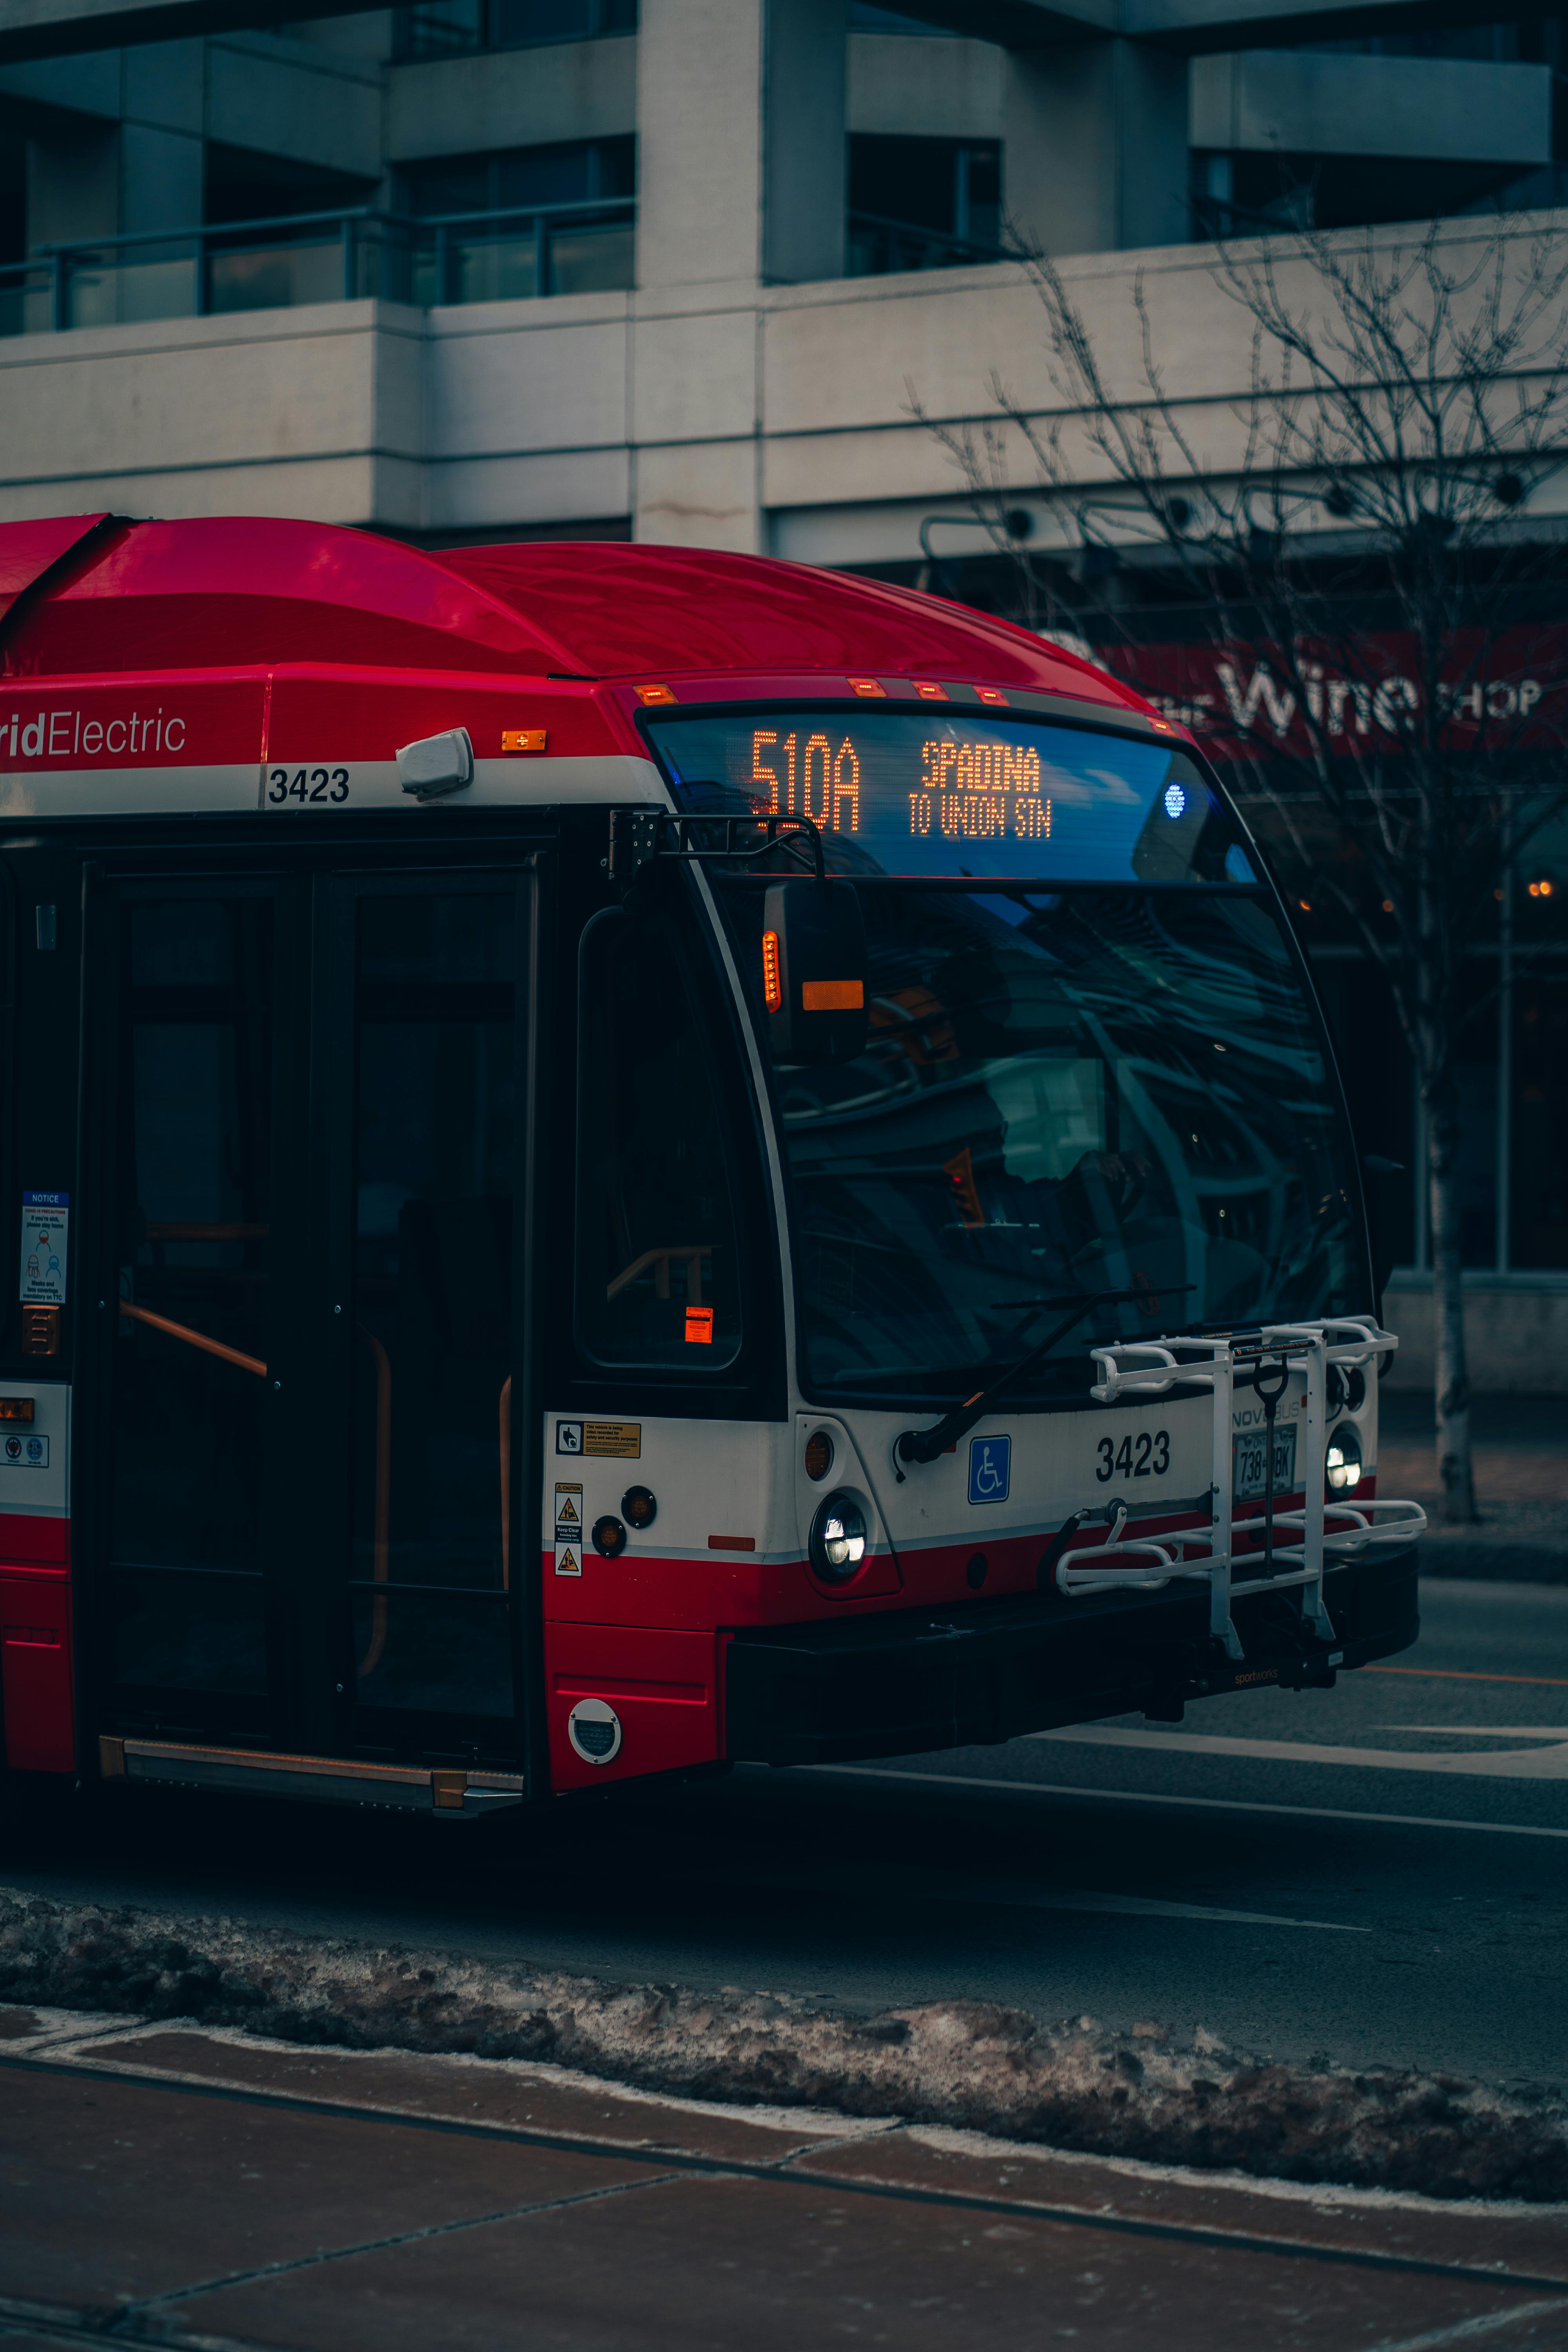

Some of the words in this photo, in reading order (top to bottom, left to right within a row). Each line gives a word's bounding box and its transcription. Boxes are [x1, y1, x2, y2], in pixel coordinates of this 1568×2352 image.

[1215, 659, 1418, 740] Wine
[1435, 679, 1542, 721] SHOP
[269, 768, 349, 804] 3423
[751, 730, 859, 831] 510A
[922, 740, 1040, 792] SPADINA
[908, 793, 931, 835] TO
[941, 794, 1005, 836] UNION
[1015, 797, 1051, 838] STN
[33, 1194, 59, 1203] NOTICE
[1096, 1430, 1170, 1482] 3423
[1235, 1668, 1278, 1686] sportworks
